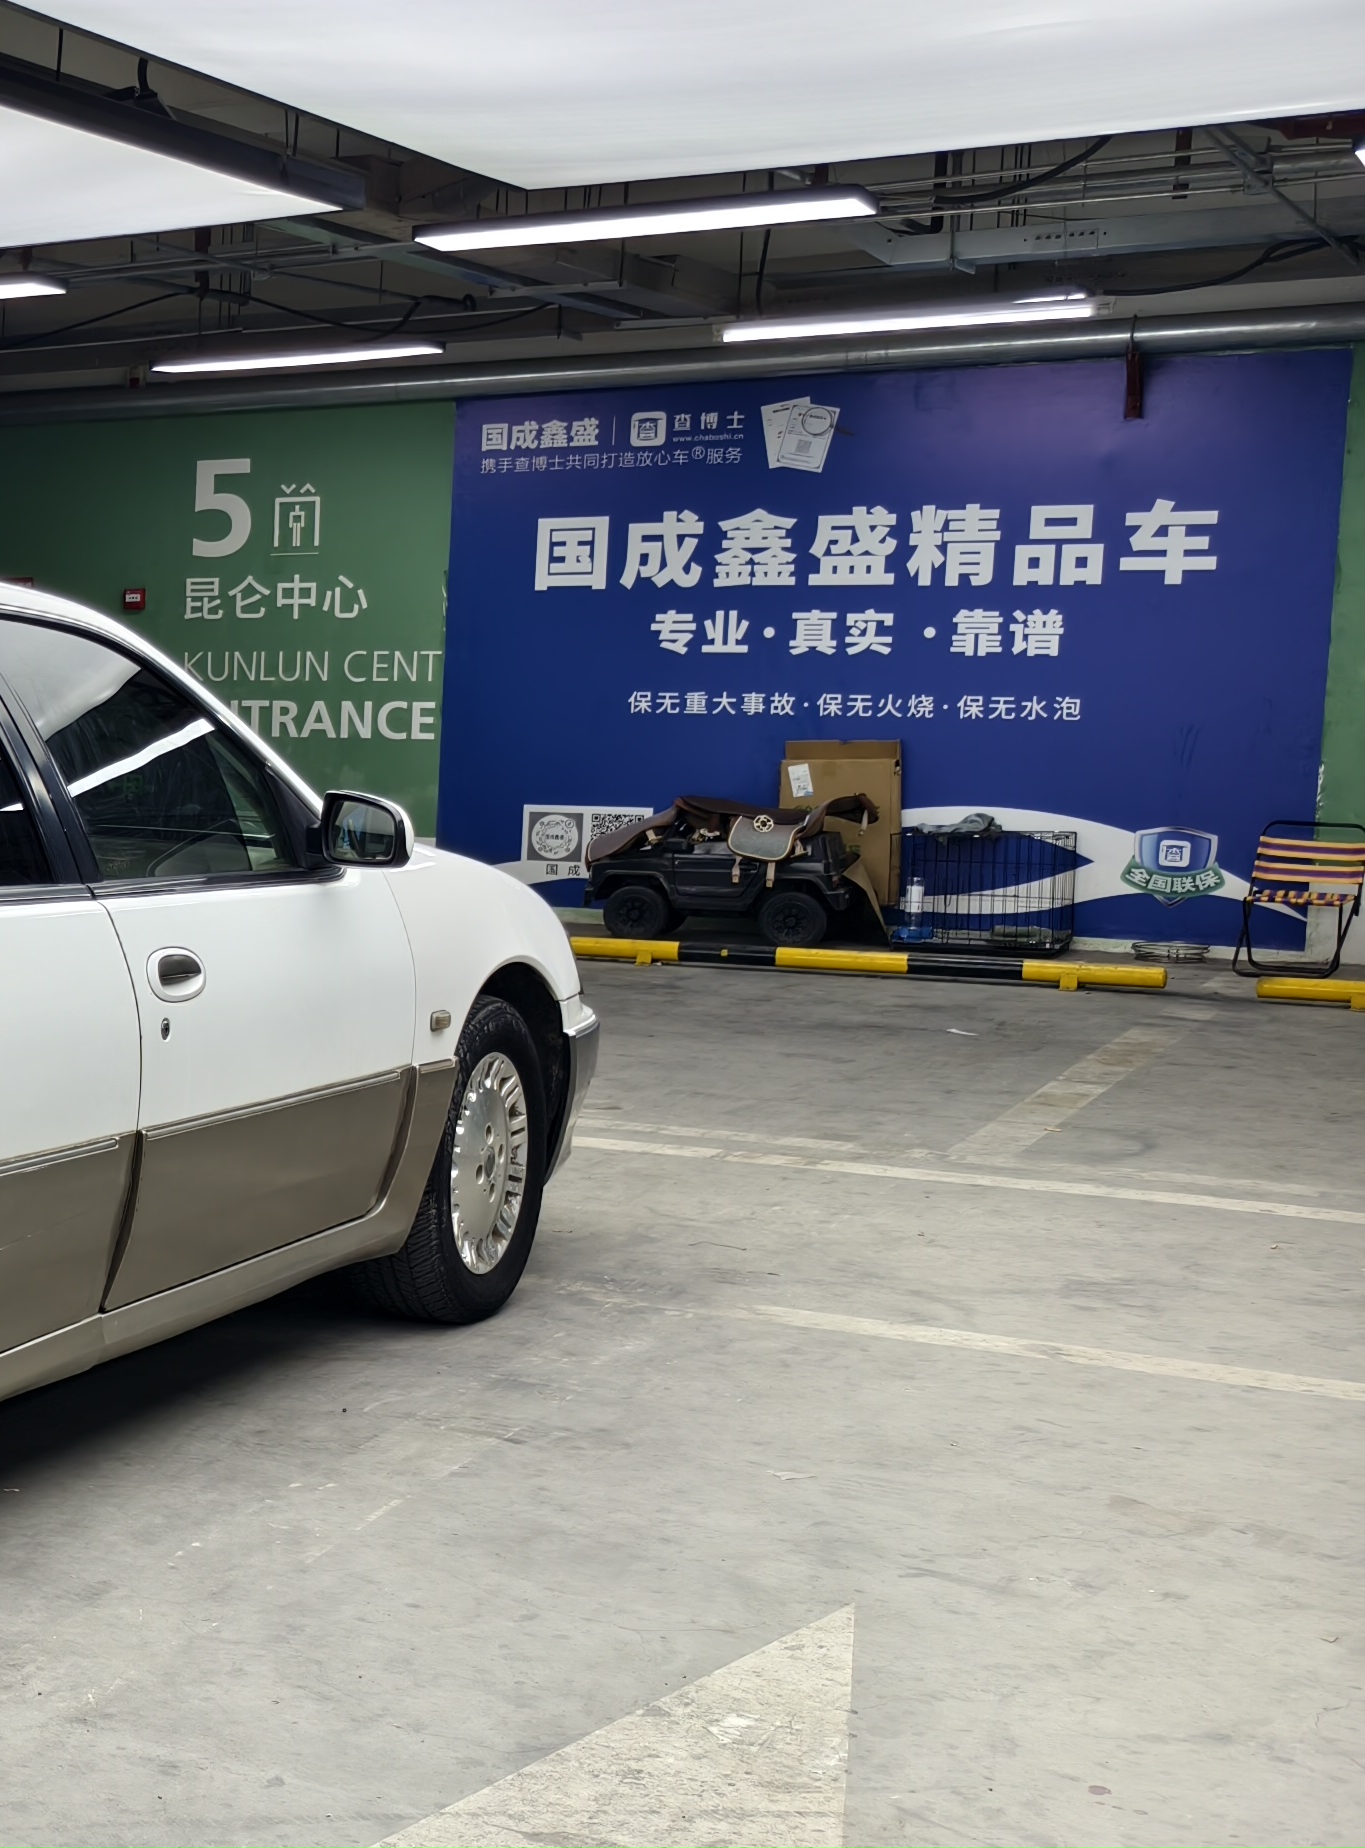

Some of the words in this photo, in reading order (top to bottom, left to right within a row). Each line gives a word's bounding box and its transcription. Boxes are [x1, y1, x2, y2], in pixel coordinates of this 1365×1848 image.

[481, 417, 600, 451] 国成鑫盛
[673, 411, 745, 431] 查博士
[192, 458, 252, 557] 5
[534, 499, 1219, 591] 国成鑫盛精品车
[184, 574, 368, 620] 昆仑中心
[184, 651, 329, 682] KUNLUN
[343, 651, 442, 682] CENT
[1124, 867, 1221, 894] 全国联保
